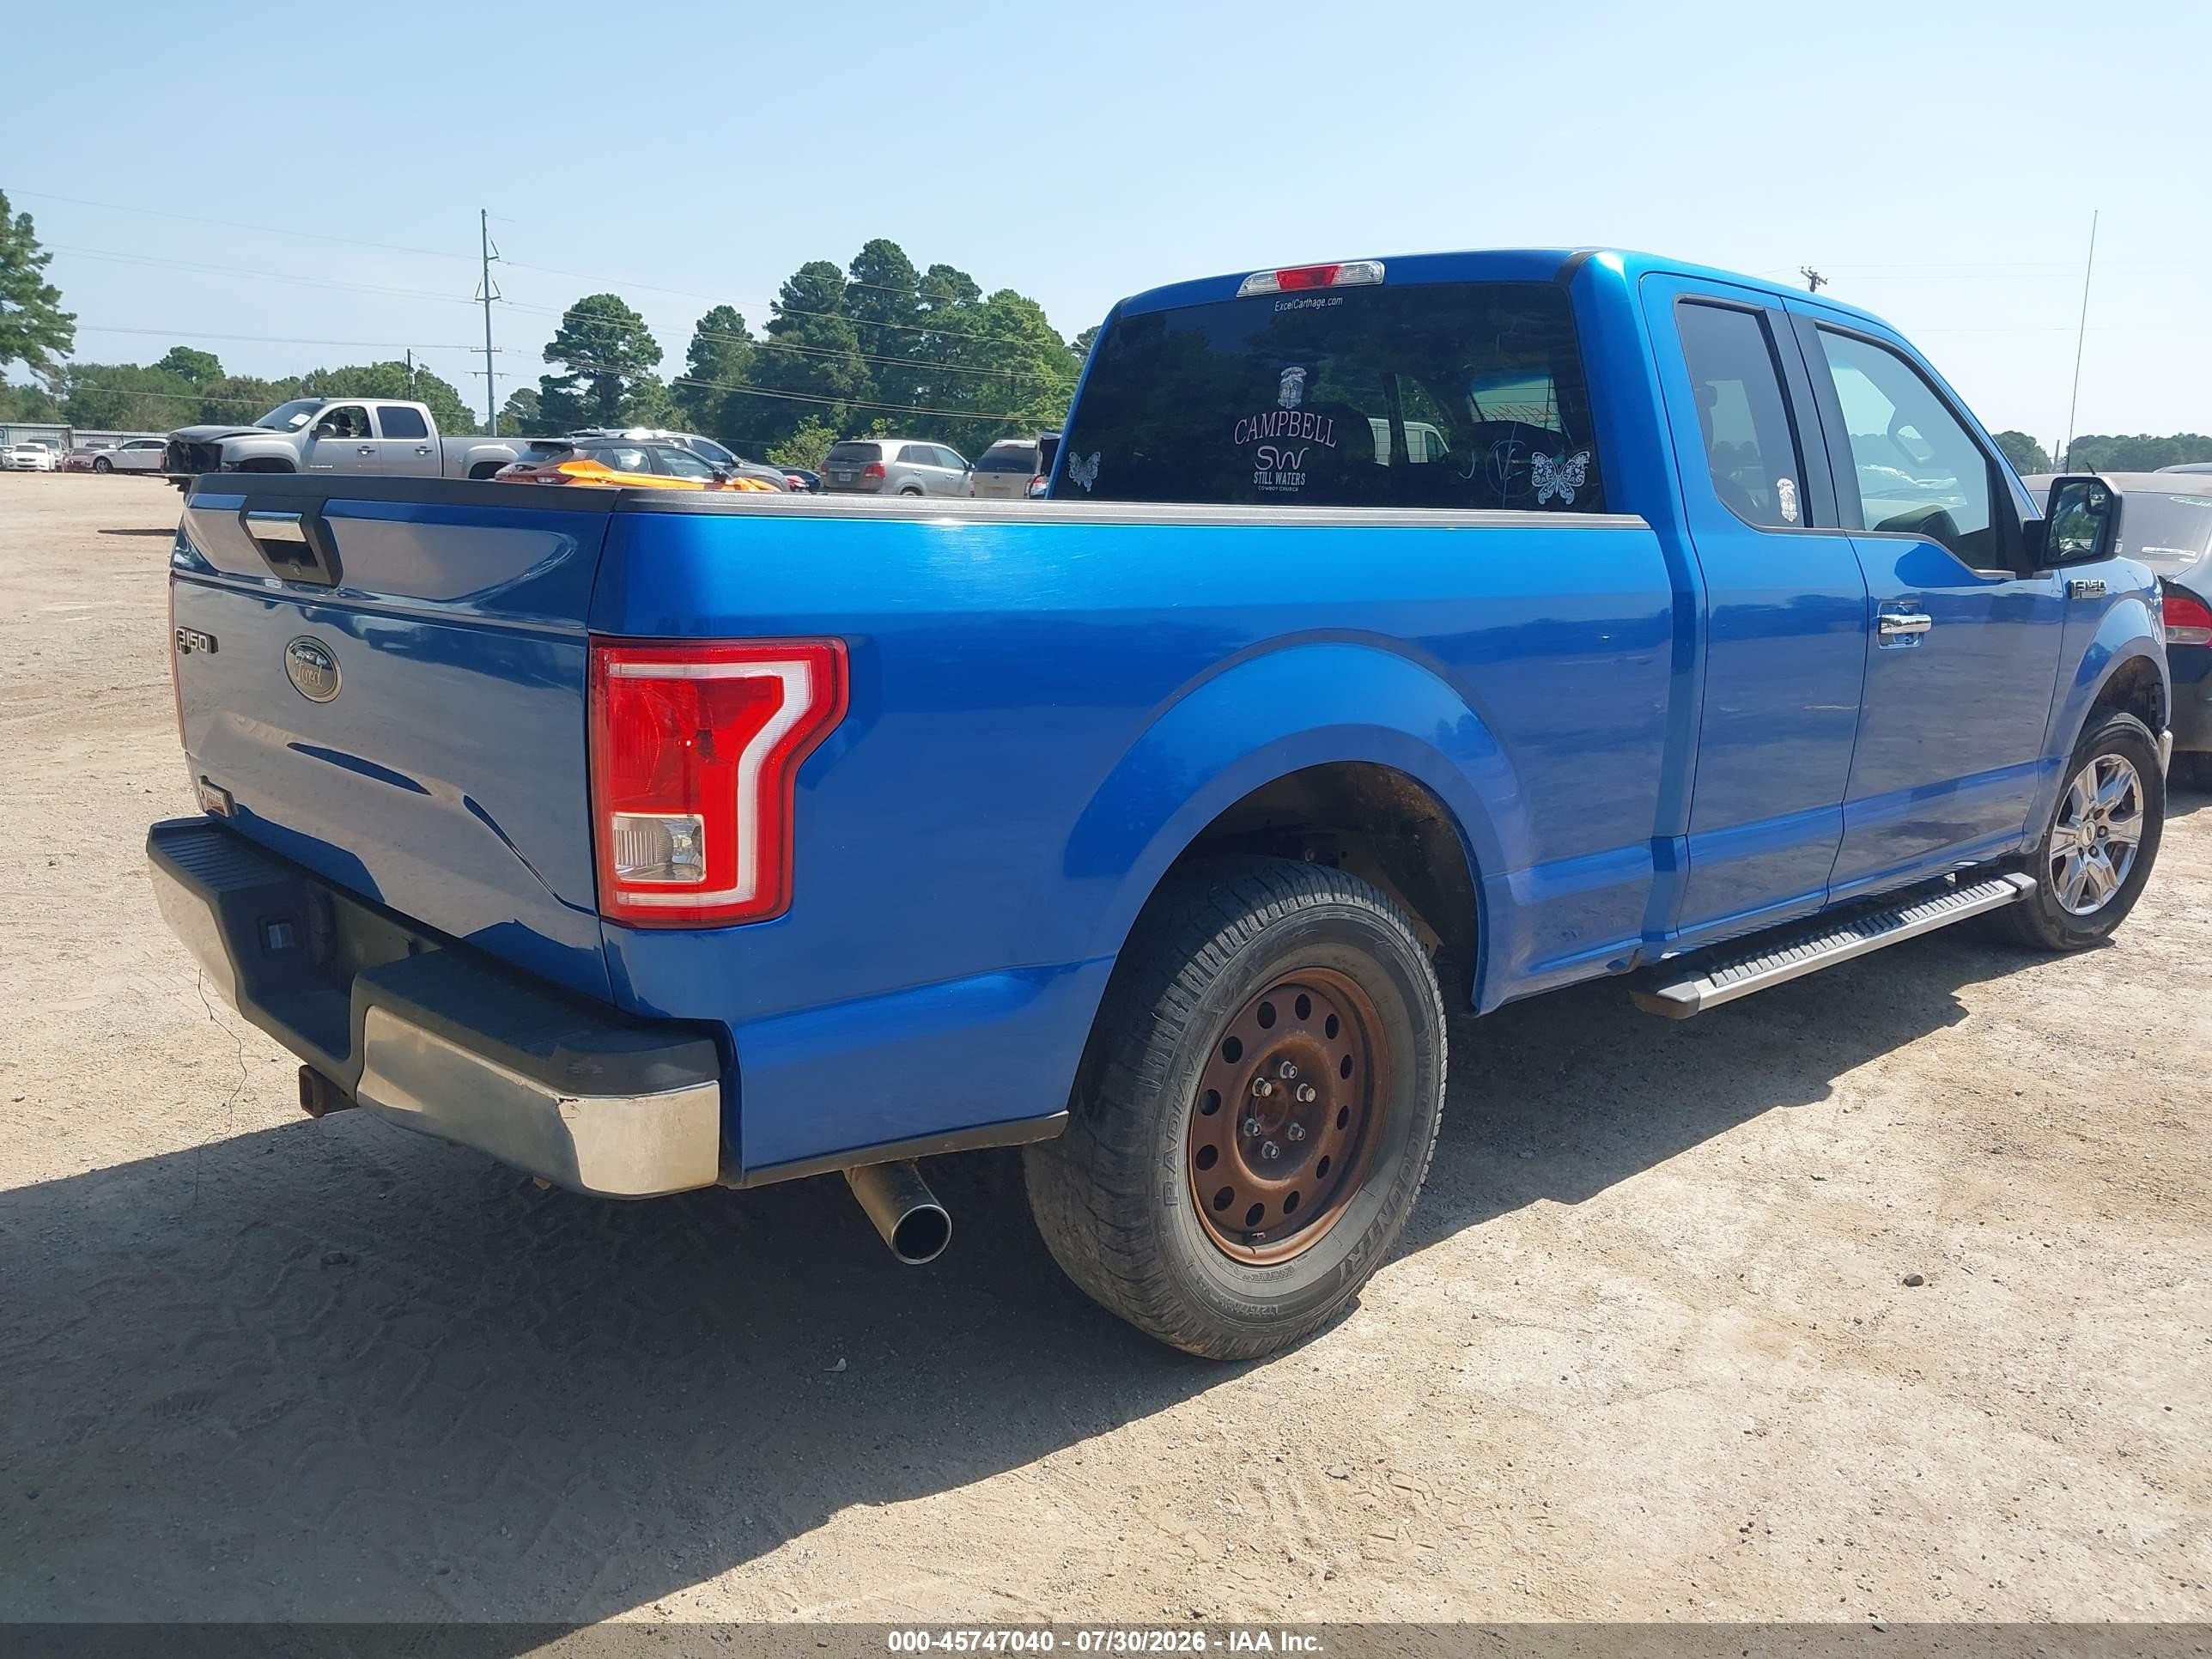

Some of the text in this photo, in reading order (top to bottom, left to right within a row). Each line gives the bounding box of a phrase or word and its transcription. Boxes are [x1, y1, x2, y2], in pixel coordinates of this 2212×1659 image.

[1273, 296, 1343, 312] ExcelCarthage.com
[1234, 410, 1337, 448] CAMPBELL
[1255, 445, 1310, 471] SW
[1254, 471, 1306, 486] STILL WATERS
[294, 650, 325, 688] Ford
